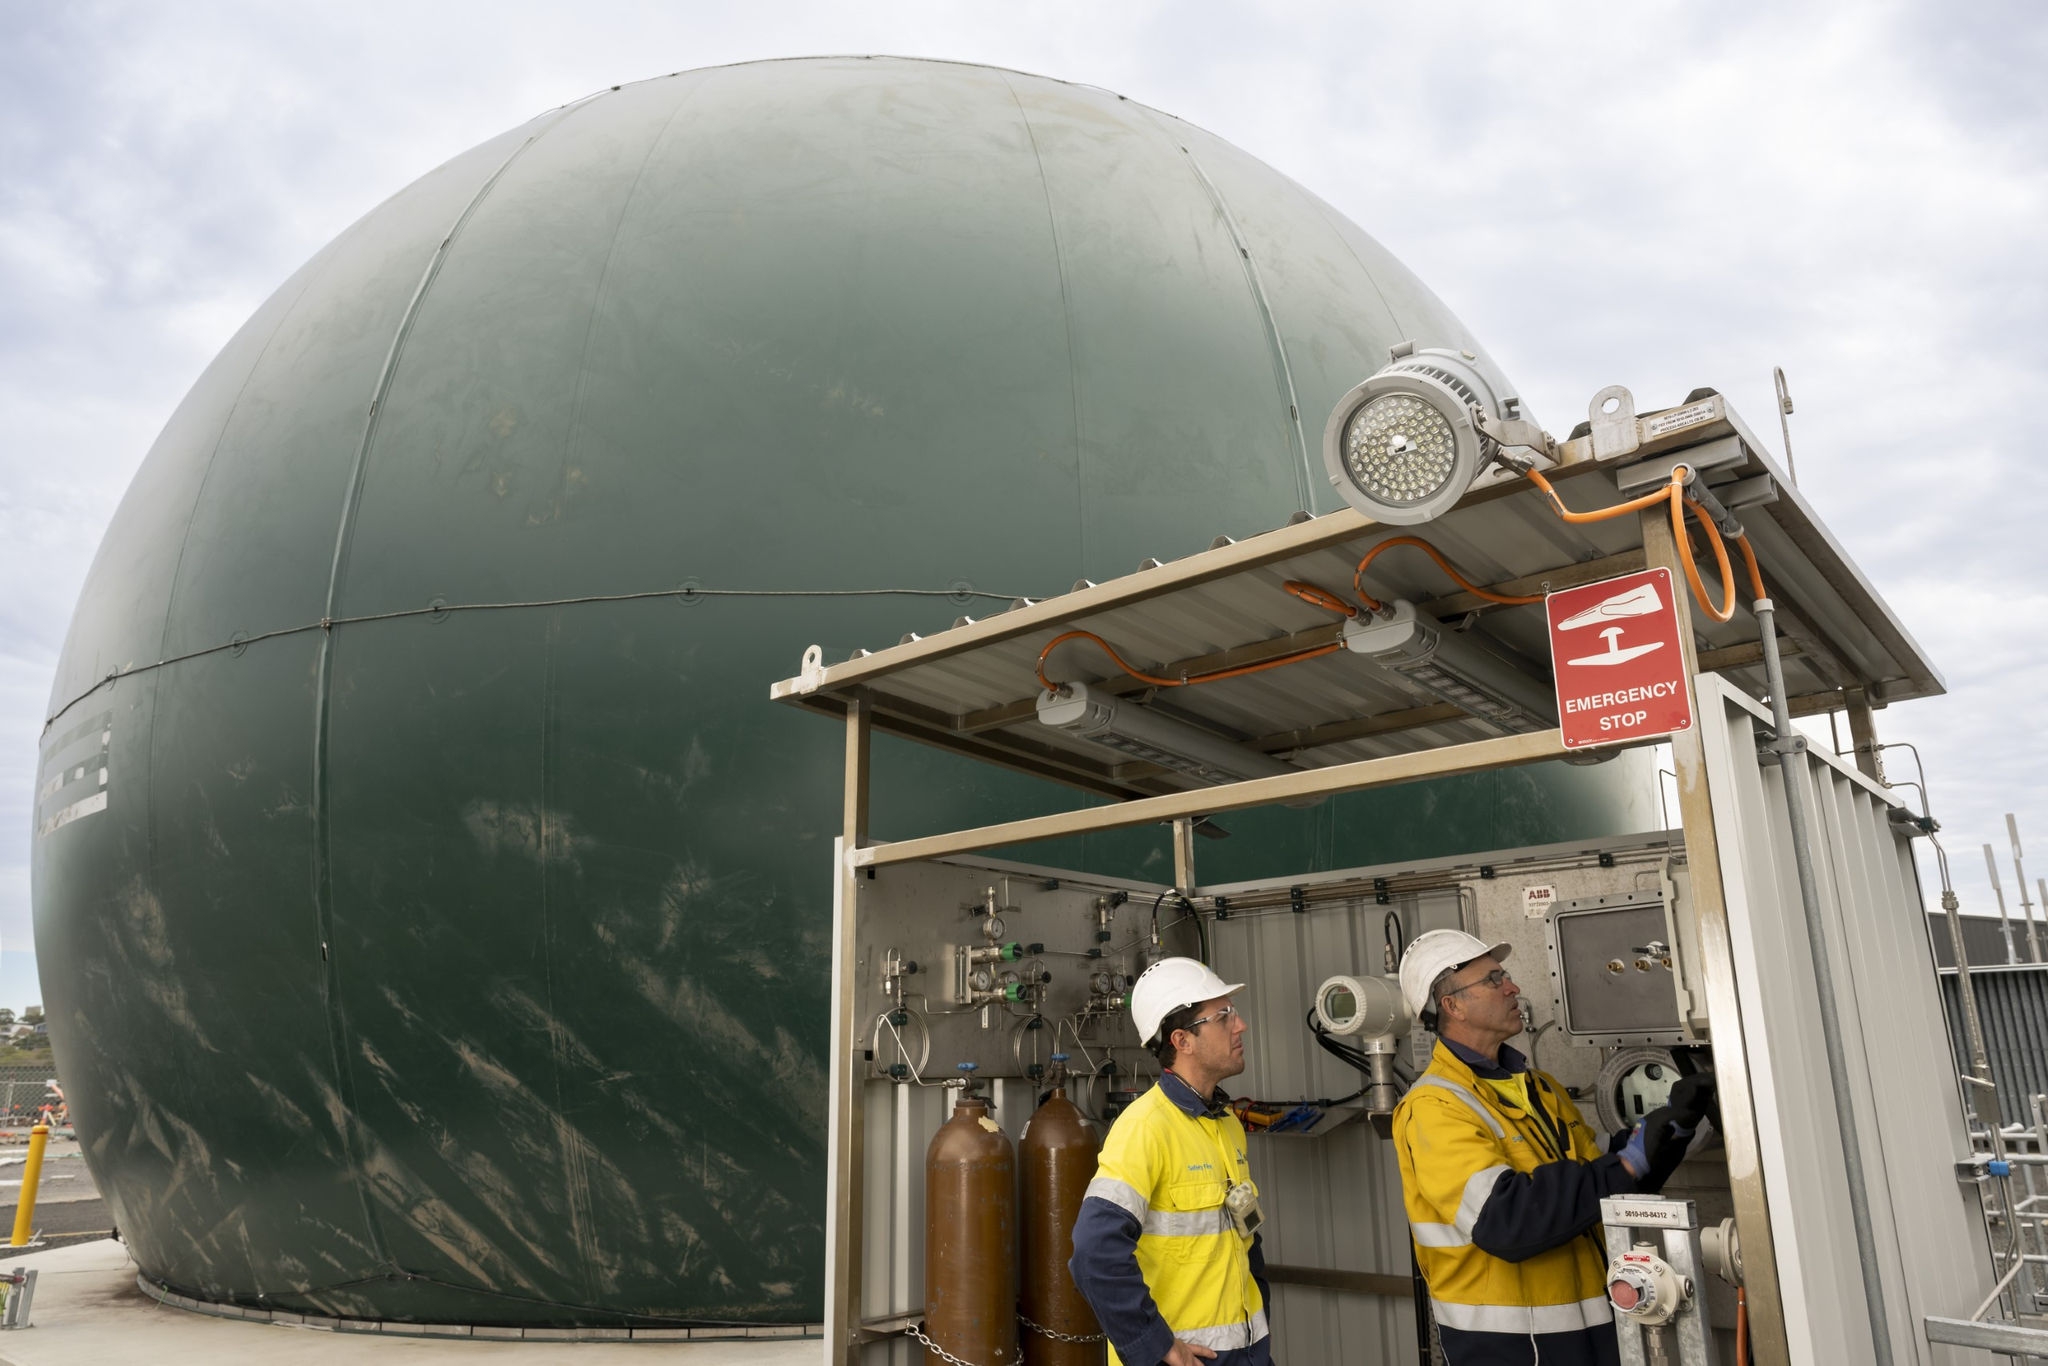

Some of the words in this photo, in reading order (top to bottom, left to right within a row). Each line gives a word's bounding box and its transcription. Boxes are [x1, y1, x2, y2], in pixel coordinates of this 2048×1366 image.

[1566, 681, 1678, 713] EMERGENCY
[1600, 711, 1647, 731] STOP
[1528, 889, 1550, 900] ABB
